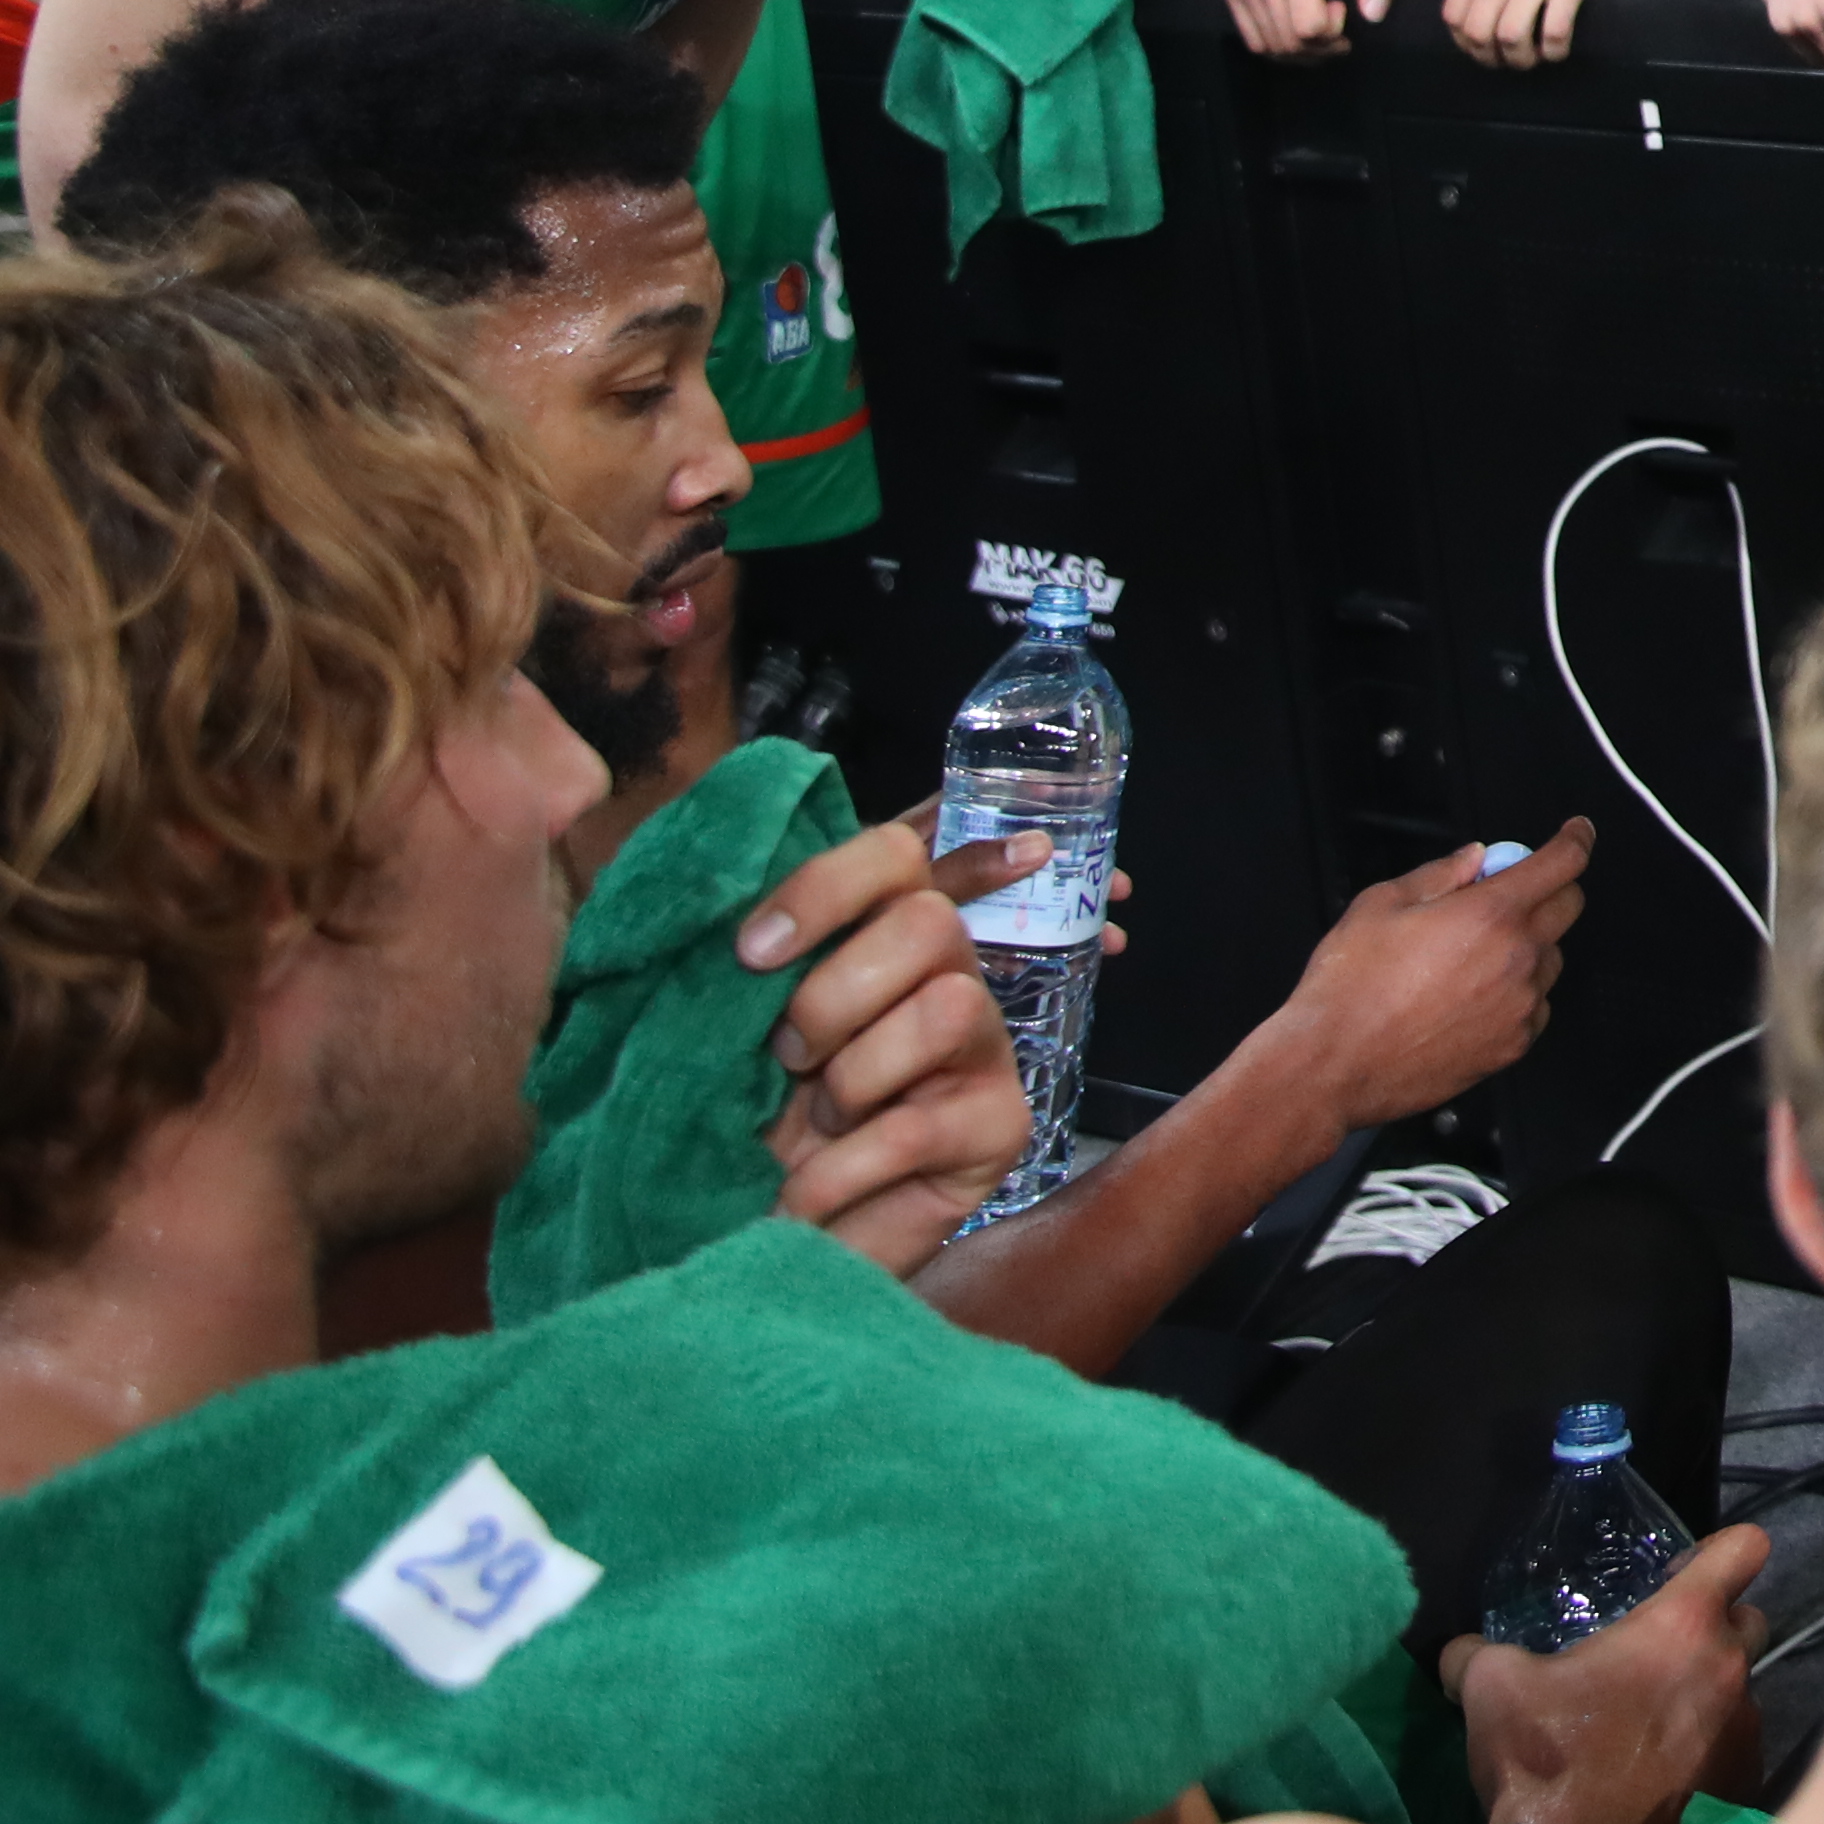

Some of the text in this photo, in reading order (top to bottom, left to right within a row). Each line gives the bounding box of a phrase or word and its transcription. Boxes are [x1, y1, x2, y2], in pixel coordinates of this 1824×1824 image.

[771, 314, 810, 354] ABA
[1077, 817, 1109, 920] Zala
[395, 1514, 546, 1633] 29
